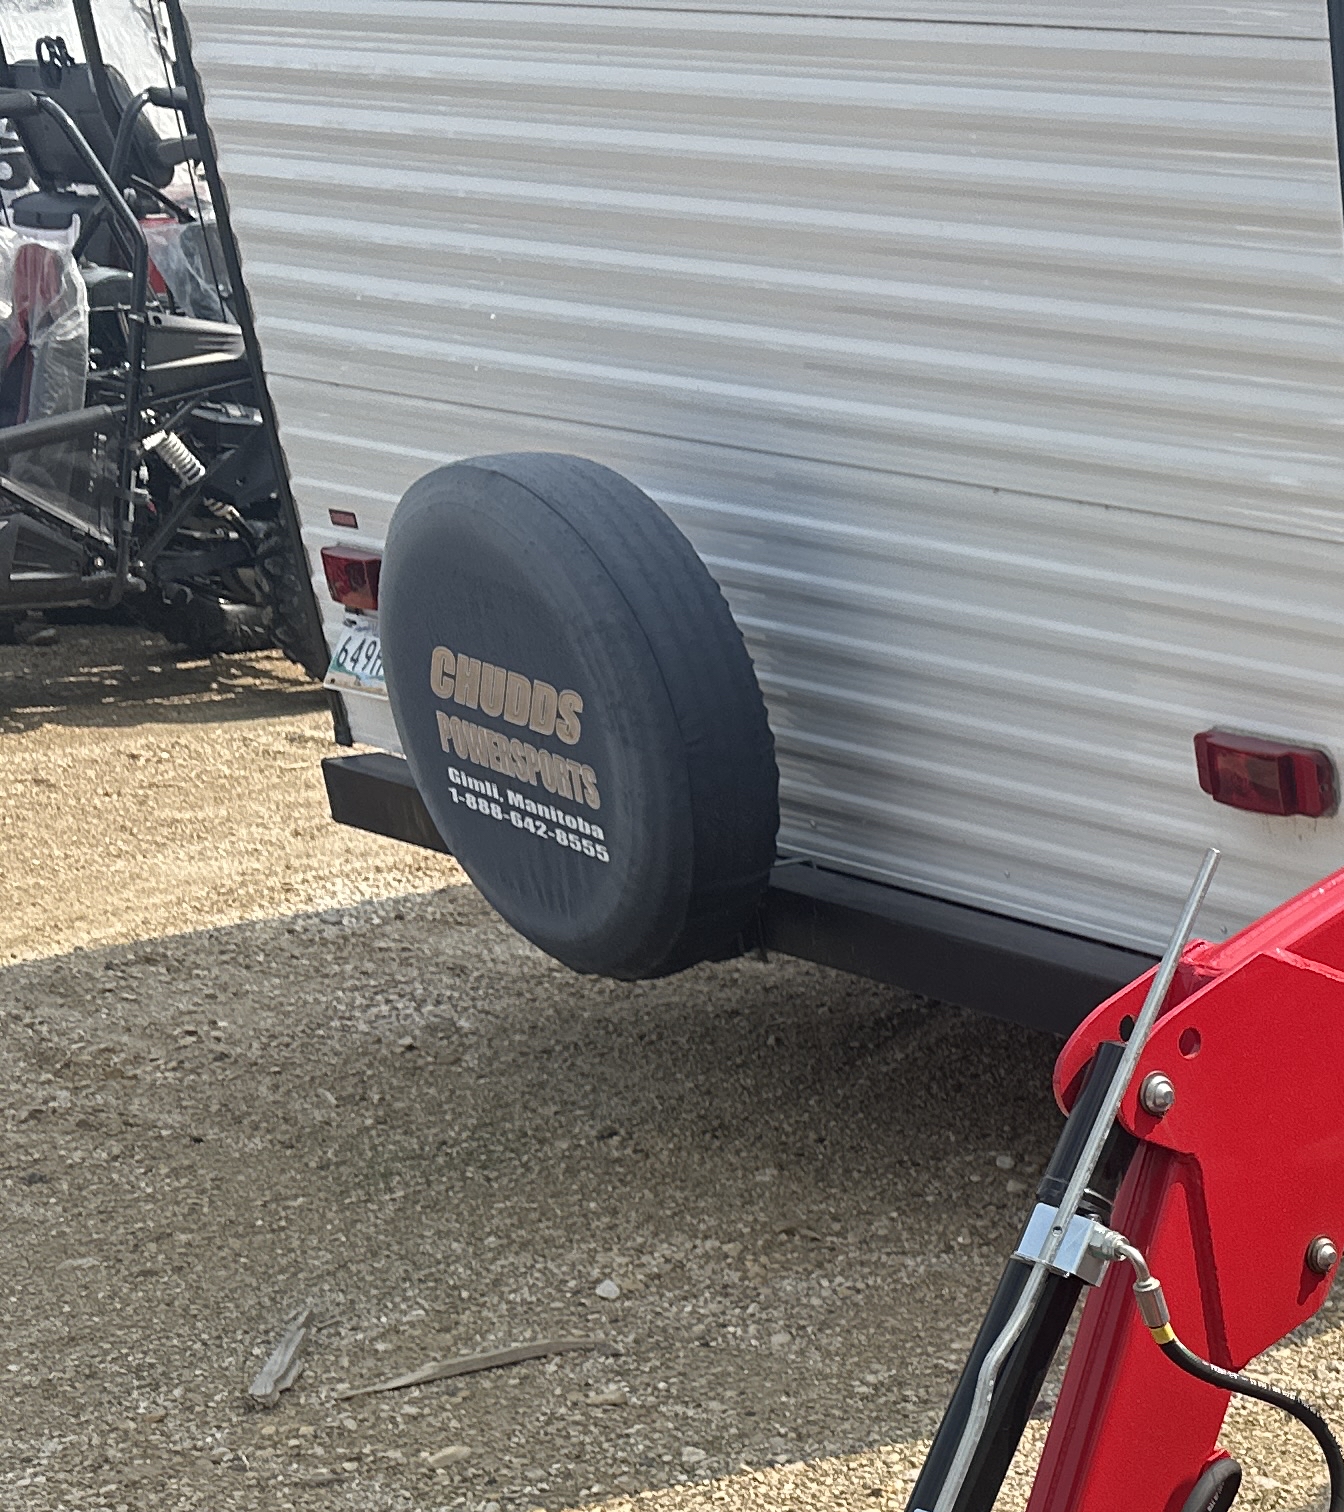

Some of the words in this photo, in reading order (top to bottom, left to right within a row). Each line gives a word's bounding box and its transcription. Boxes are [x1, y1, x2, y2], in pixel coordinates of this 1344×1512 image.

[430, 645, 584, 745] CHUDDS
[436, 709, 601, 810] POWERSPORTS
[447, 766, 504, 803] Gimli,
[506, 788, 605, 841] Manitoba
[448, 786, 610, 864] 1-888-642-8555
